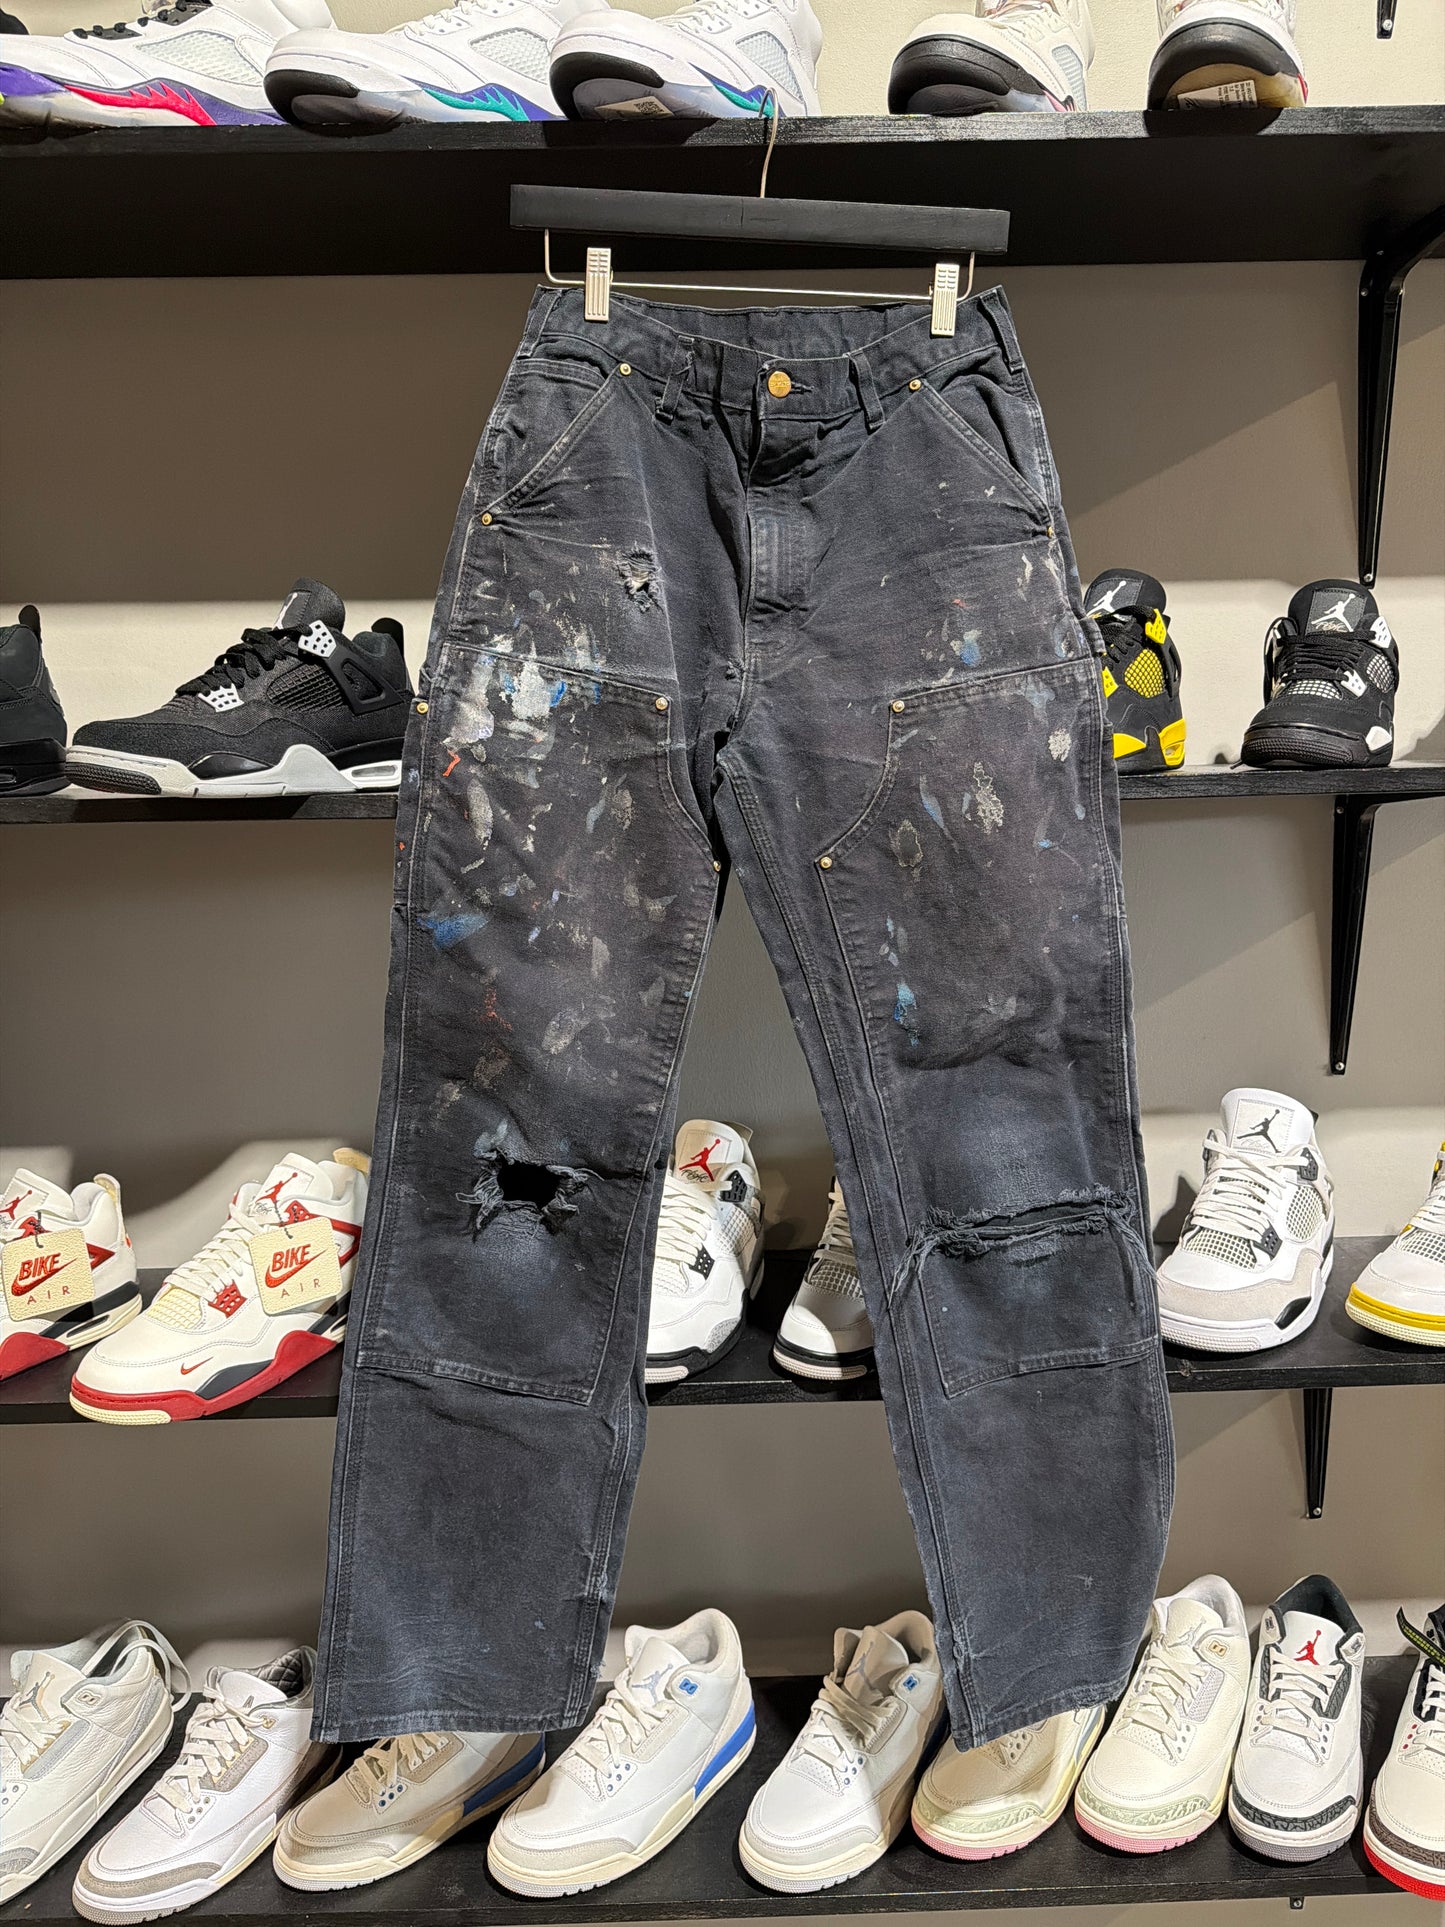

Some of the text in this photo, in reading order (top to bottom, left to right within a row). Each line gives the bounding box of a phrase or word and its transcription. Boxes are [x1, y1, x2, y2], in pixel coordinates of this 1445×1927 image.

[18, 1252, 61, 1282] BIKE
[271, 1243, 311, 1273] BIKE
[27, 1285, 70, 1305] AIR
[281, 1278, 321, 1299] AIR
